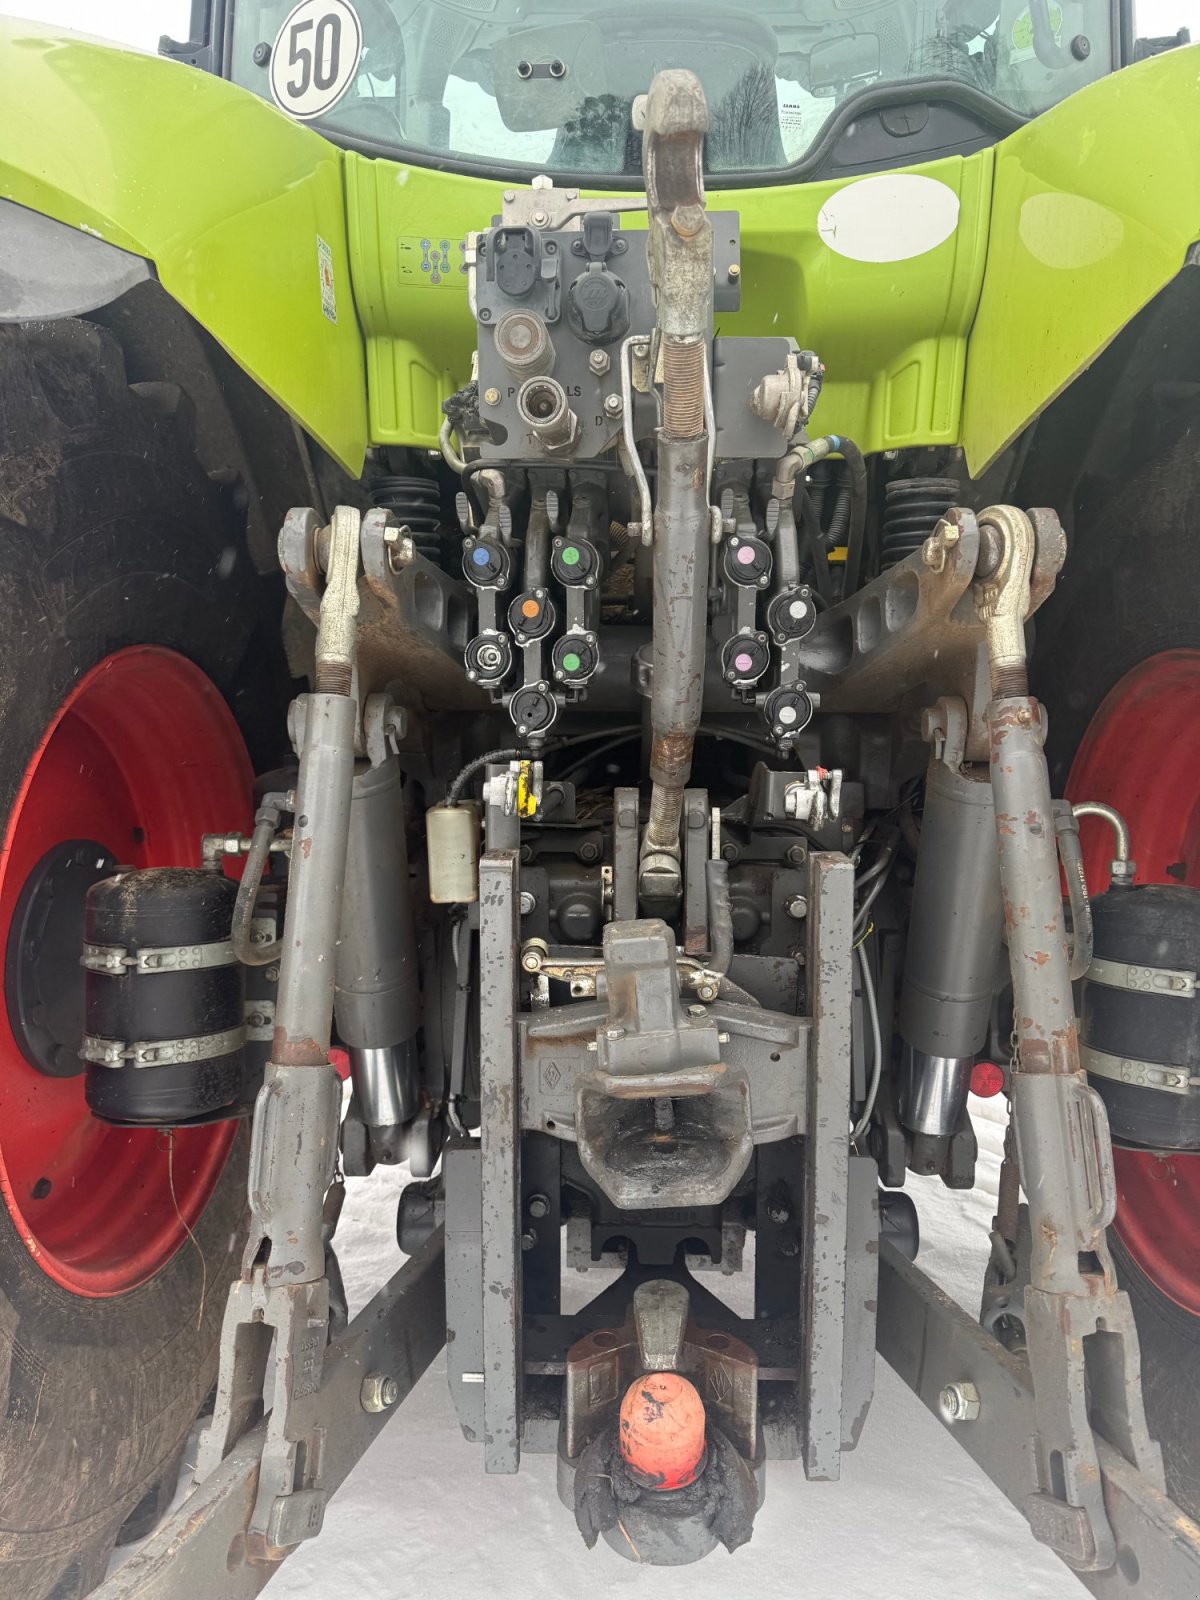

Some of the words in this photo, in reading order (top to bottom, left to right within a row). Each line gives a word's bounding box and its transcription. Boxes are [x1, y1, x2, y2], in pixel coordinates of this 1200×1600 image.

[286, 12, 342, 99] 50
[507, 387, 515, 398] P
[566, 386, 582, 397] LS
[595, 415, 603, 426] D
